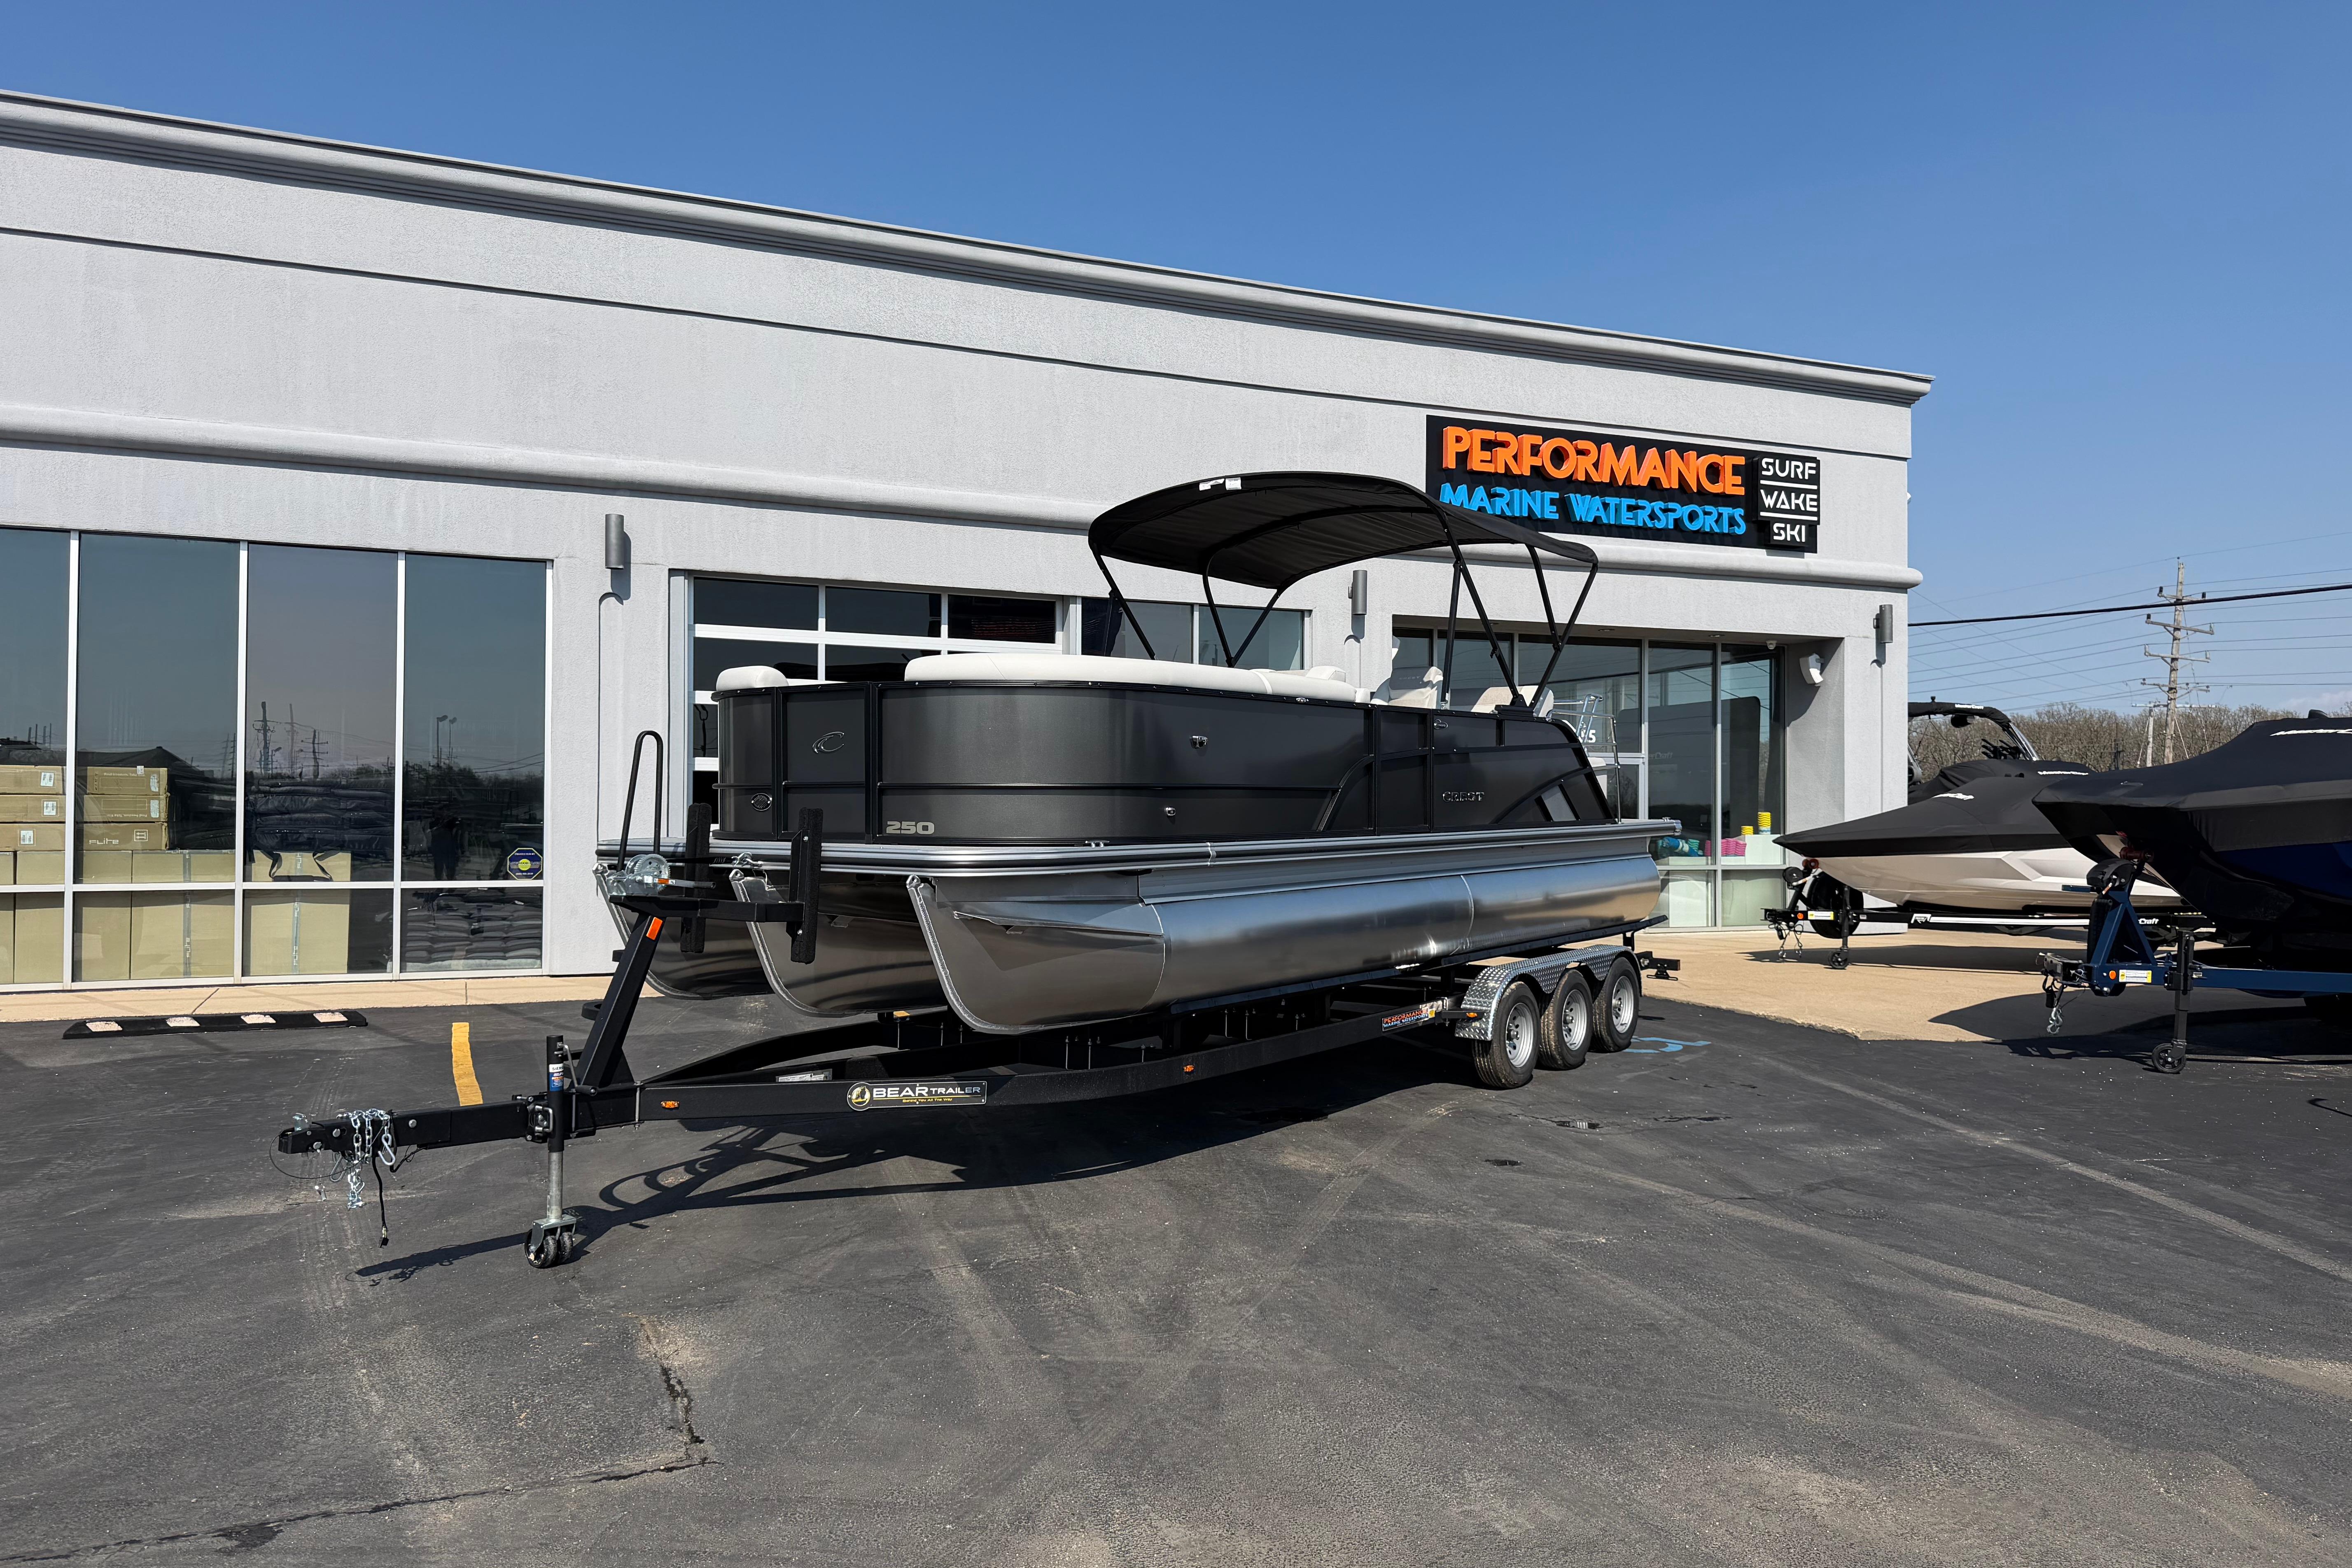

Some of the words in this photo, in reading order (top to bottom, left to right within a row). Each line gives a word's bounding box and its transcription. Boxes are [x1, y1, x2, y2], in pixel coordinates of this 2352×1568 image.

[1442, 426, 1745, 495] PERFORMANCE
[1762, 457, 1816, 480] SURF
[1440, 482, 1559, 519] MARINE
[1564, 494, 1746, 535] WATERSPORTS
[1760, 489, 1818, 512] WAKE
[1773, 523, 1806, 542] SKI
[1442, 791, 1485, 802] CREST
[886, 821, 935, 835] 250
[1402, 1013, 1428, 1023] WATERSPORTS
